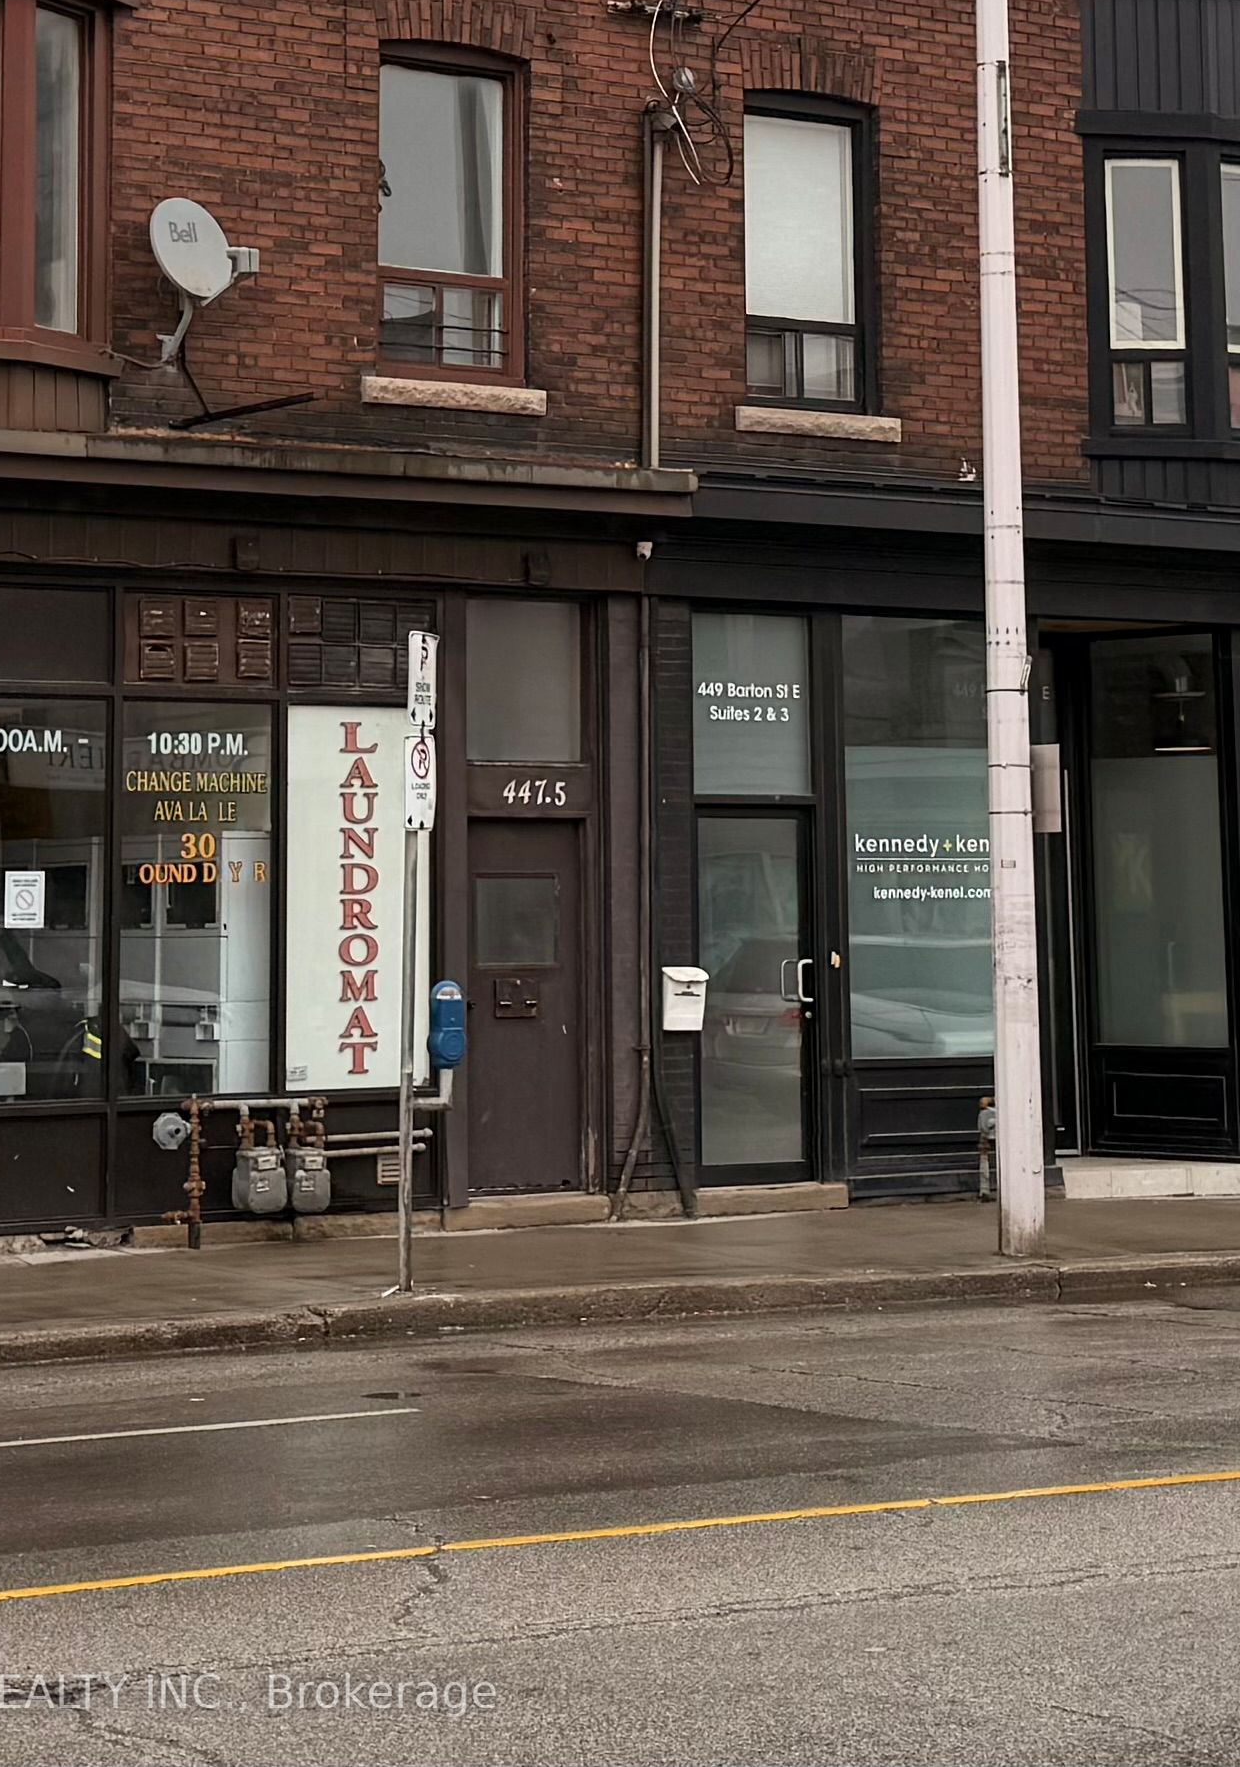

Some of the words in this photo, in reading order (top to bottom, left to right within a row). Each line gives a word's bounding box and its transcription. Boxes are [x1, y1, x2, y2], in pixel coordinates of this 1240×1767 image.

[168, 221, 198, 243] Bell
[697, 681, 723, 697] 449
[727, 682, 773, 698] Barton
[776, 684, 788, 699] St
[792, 684, 801, 699] E
[709, 705, 750, 721] Suites
[753, 706, 763, 722] 2
[766, 707, 777, 722] &
[780, 707, 790, 722] 3
[147, 732, 201, 755] 10:30
[207, 733, 249, 756] P.M.
[126, 771, 192, 792] CHANGE
[196, 772, 267, 794] MACHINE
[503, 779, 566, 807] 447.5
[180, 833, 217, 859] 30
[855, 834, 940, 858] kennedy
[956, 834, 990, 853] ken
[856, 864, 884, 873] HIGH
[888, 864, 969, 873] PERFORMANCE
[974, 864, 989, 873] HO
[338, 721, 379, 1075] LAUNDROMAT
